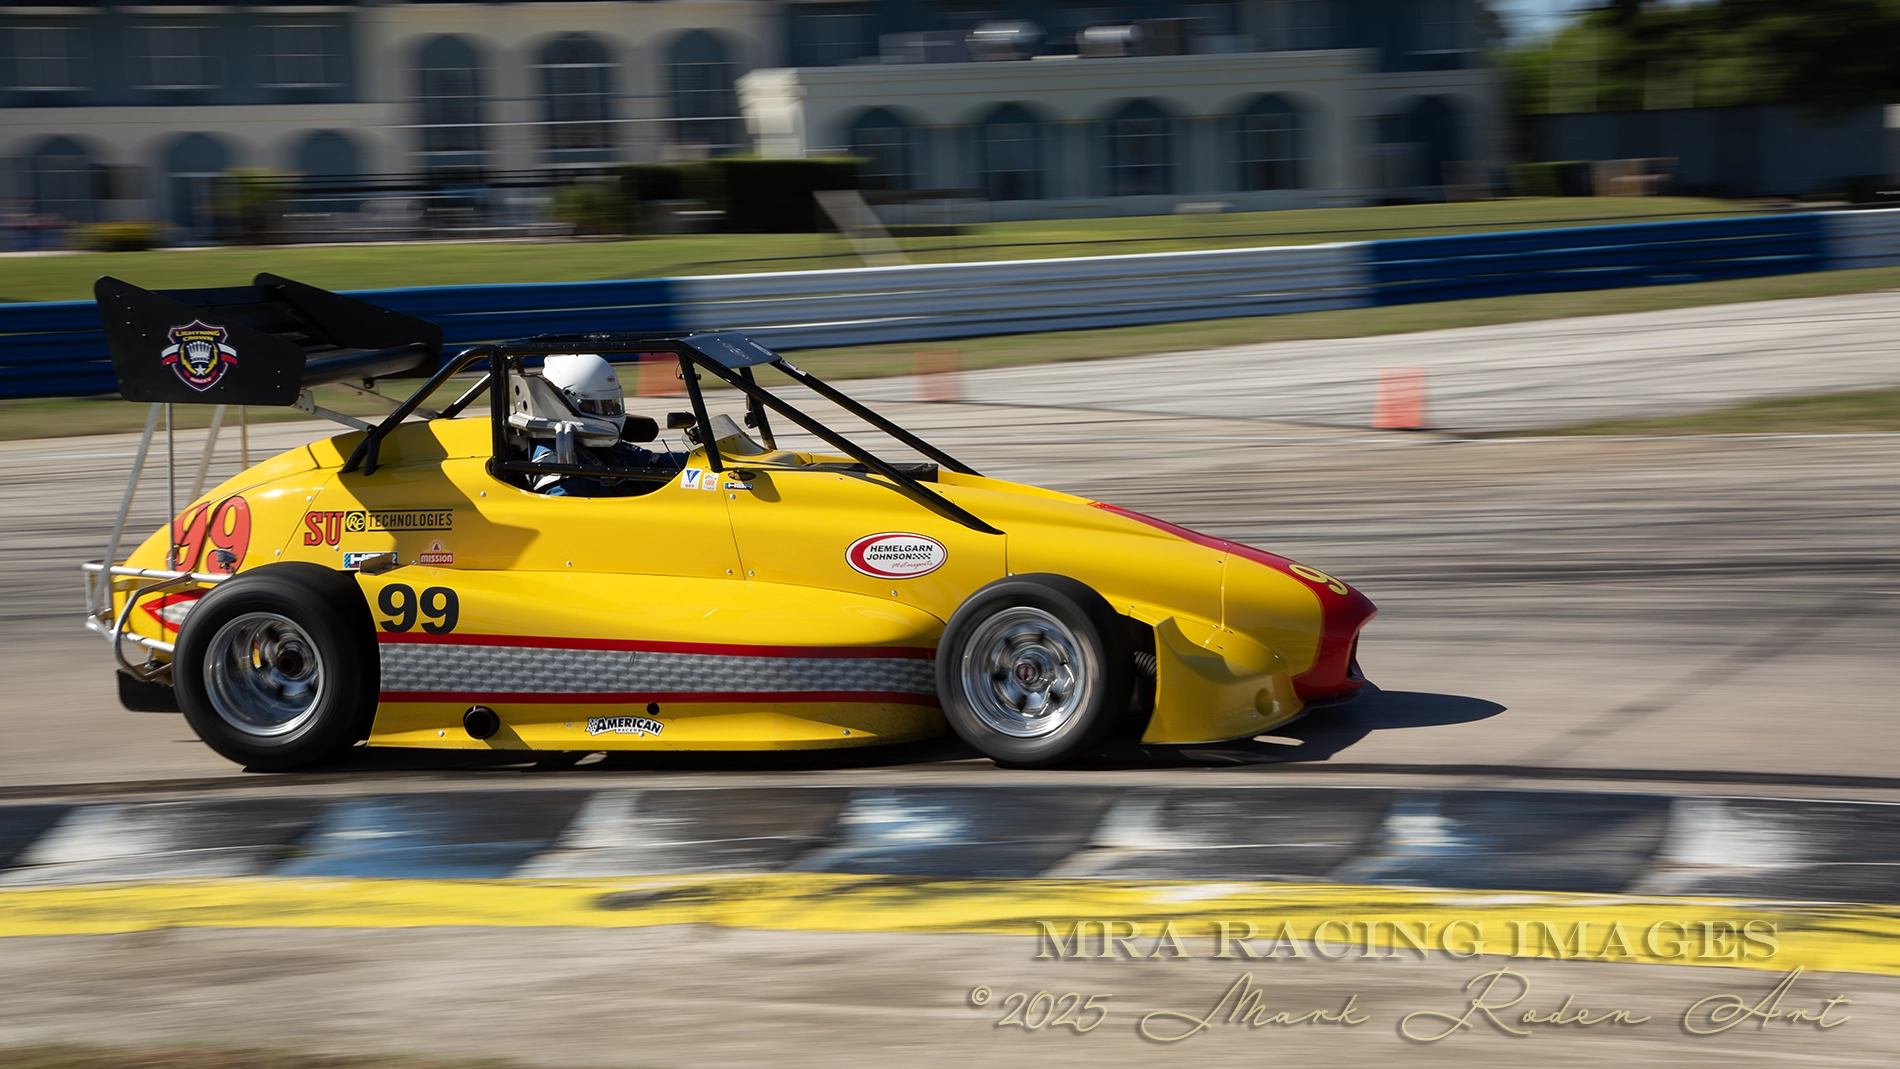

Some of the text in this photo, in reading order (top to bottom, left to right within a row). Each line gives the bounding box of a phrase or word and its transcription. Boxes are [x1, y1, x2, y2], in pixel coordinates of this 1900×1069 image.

[166, 495, 251, 575] 99
[304, 510, 344, 546] SU
[369, 513, 453, 528] TECHNOLOGIES
[870, 544, 933, 552] HEMELGARN
[866, 553, 913, 561] JOHNSON
[890, 560, 933, 570] Motorsports
[377, 583, 460, 635] 99
[594, 718, 662, 734] AMERICAN
